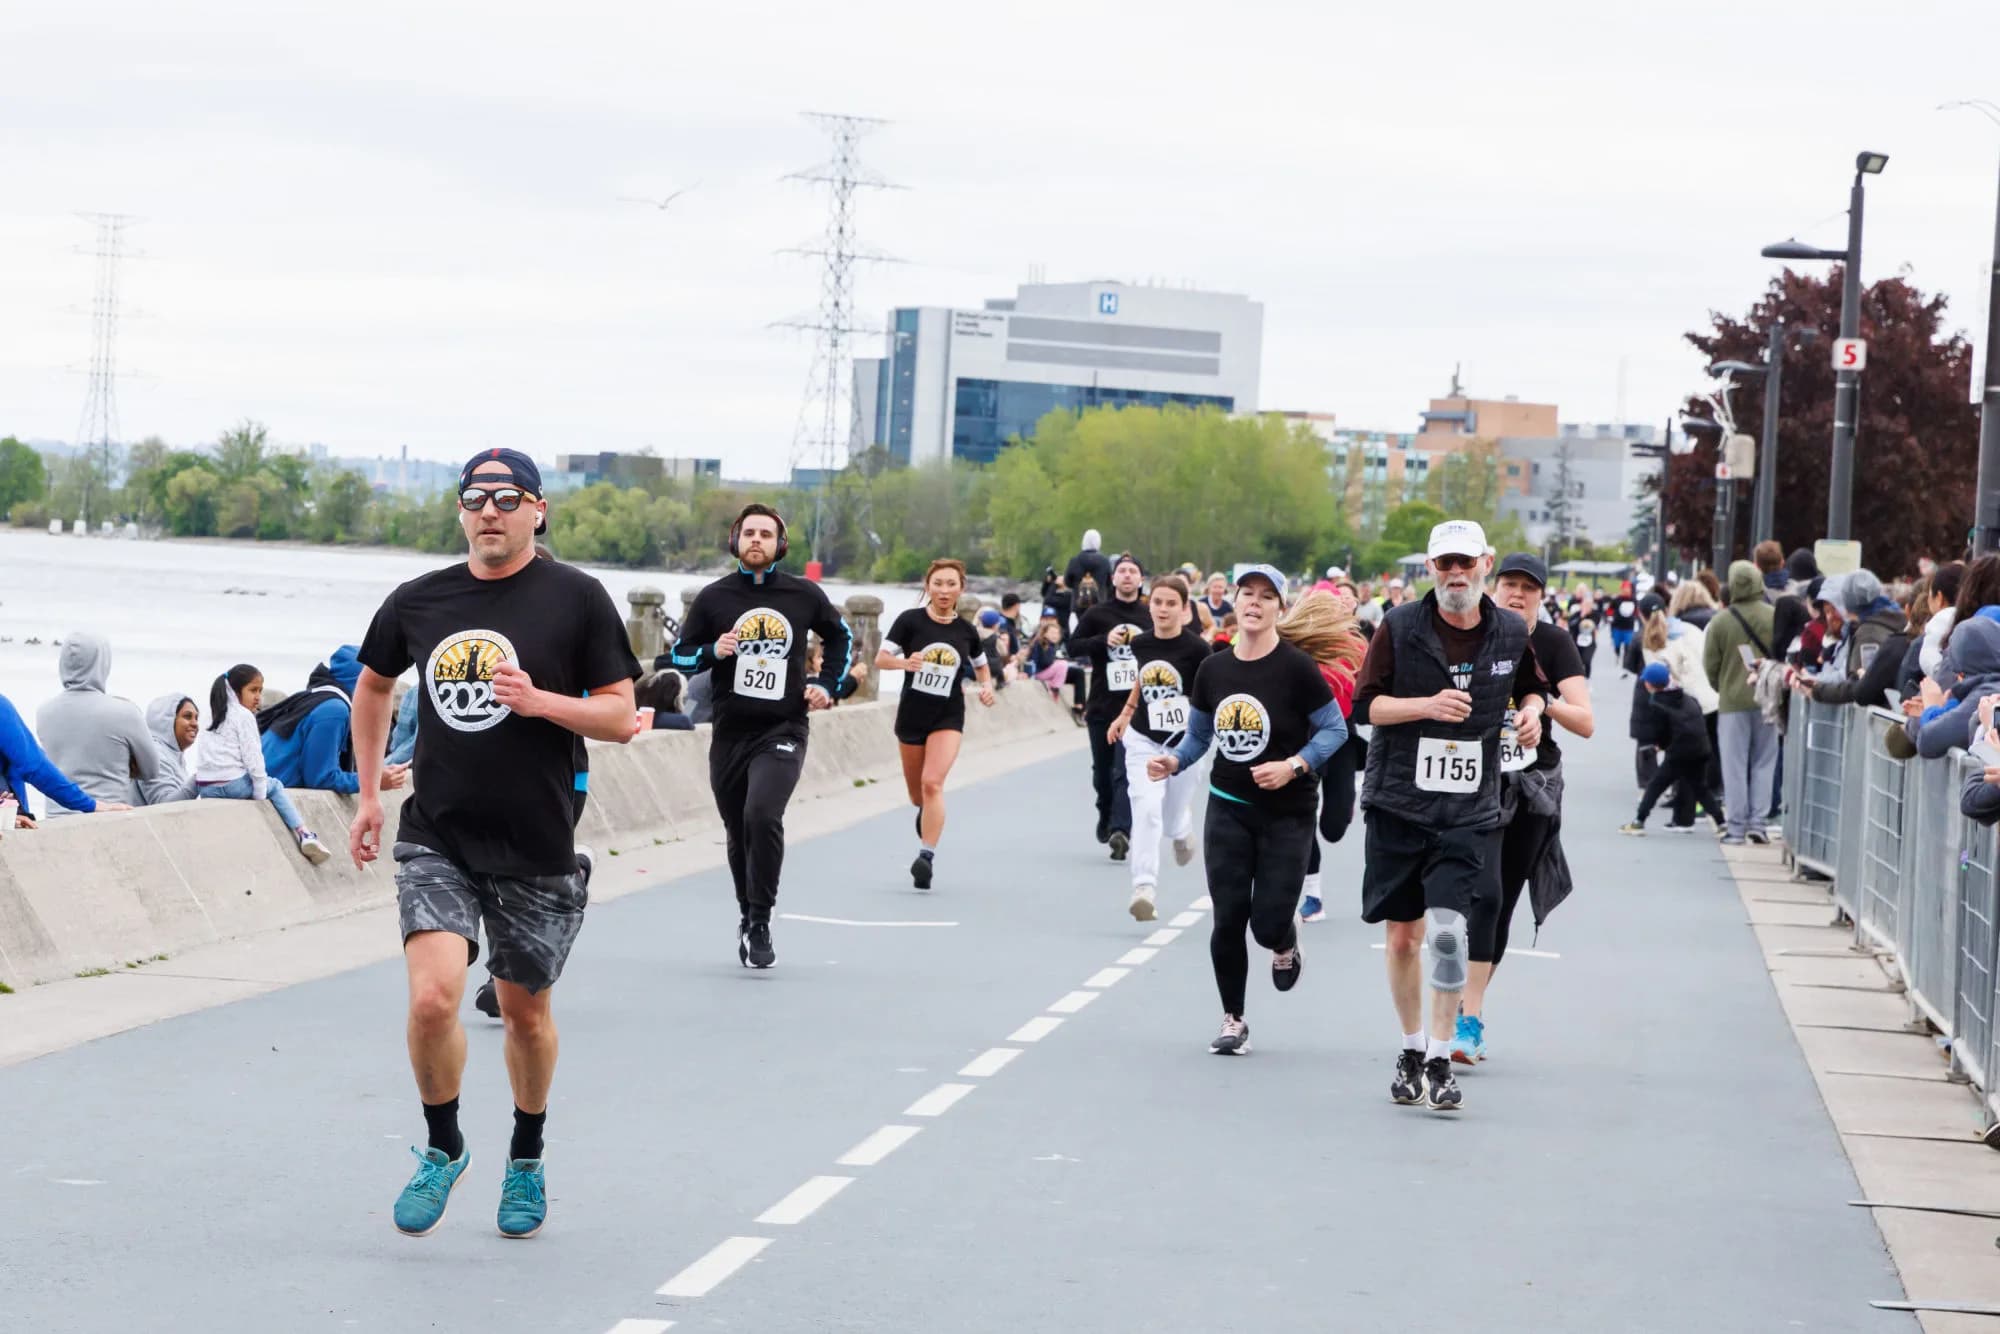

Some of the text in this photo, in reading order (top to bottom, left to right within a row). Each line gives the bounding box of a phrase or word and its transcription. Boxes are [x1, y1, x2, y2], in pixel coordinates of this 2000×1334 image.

[1102, 294, 1116, 313] H
[1843, 344, 1857, 365] 5
[740, 639, 785, 659] 2025
[743, 669, 776, 690] 520
[918, 672, 949, 689] 1077
[1114, 670, 1136, 684] 678
[1156, 708, 1184, 728] 740
[1424, 755, 1476, 781] 1155
